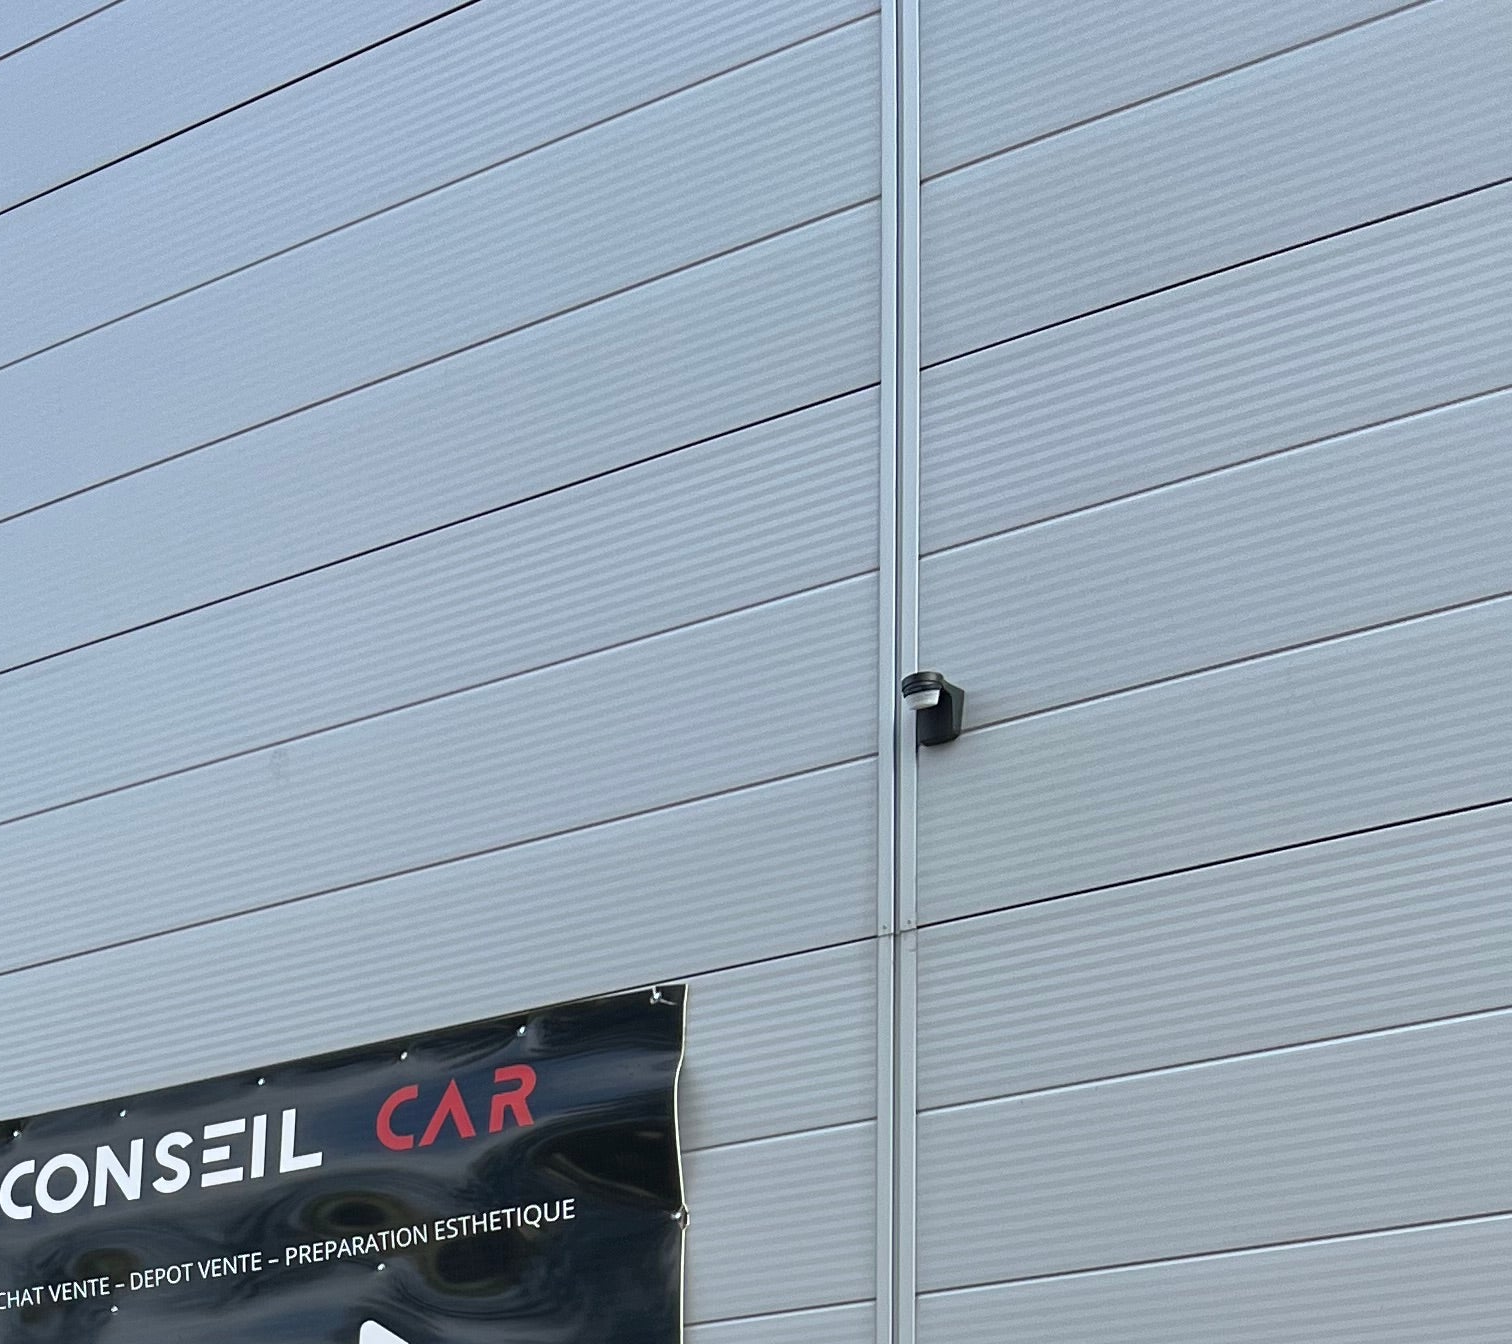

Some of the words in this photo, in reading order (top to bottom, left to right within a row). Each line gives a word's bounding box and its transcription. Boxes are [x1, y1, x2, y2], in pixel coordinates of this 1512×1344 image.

[375, 1064, 538, 1151] CAR
[48, 1276, 111, 1304] VENTE
[130, 1262, 194, 1291] DEPOT
[197, 1250, 263, 1279] VENTE
[285, 1222, 428, 1266] PREPARATION
[434, 1197, 577, 1242] ESTHETIQUE
